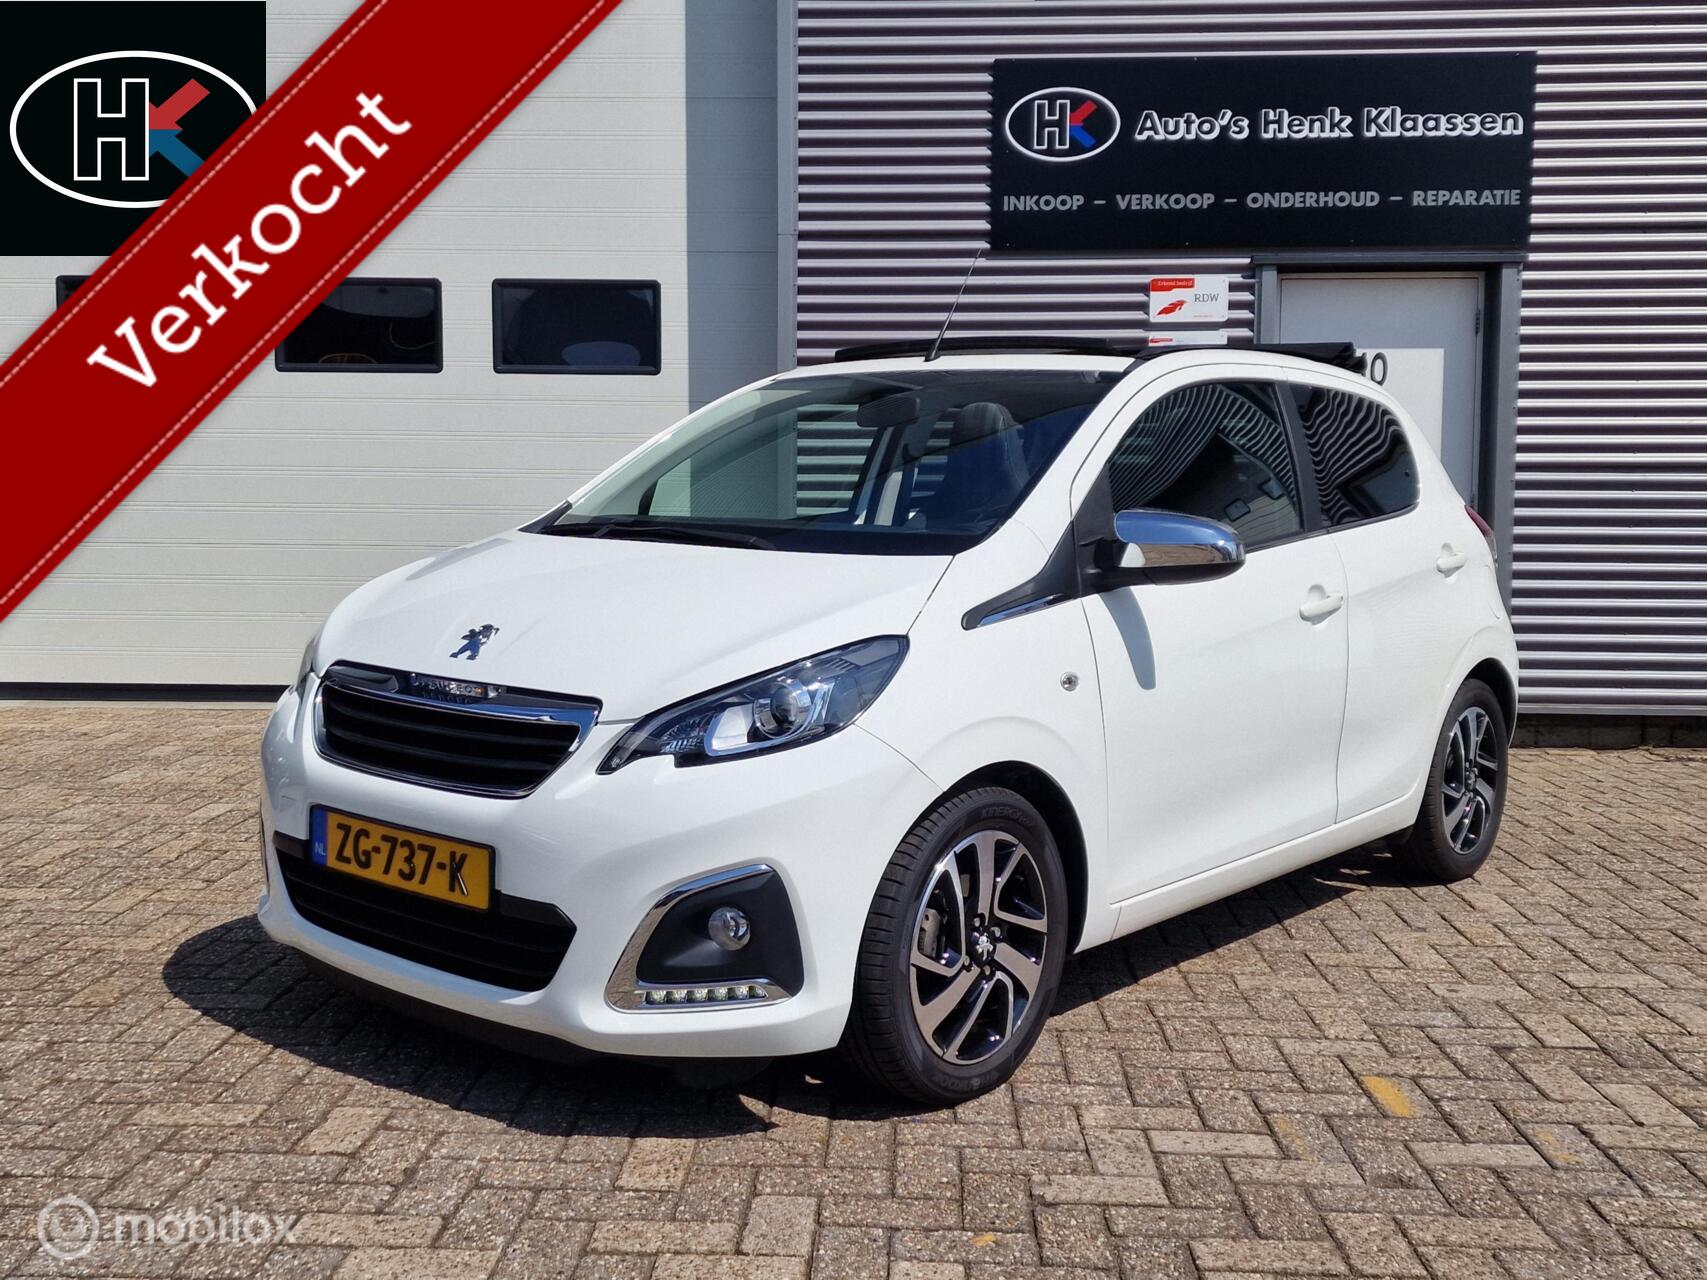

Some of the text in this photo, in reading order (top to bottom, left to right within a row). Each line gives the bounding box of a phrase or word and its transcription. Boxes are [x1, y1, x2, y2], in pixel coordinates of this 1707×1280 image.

[1134, 105, 1524, 140] Auto's Henk Klaassen
[1003, 194, 1085, 211] INKOOP
[1116, 192, 1215, 210] VERKOOP
[1246, 190, 1380, 208] ONDERHOUD
[1412, 189, 1521, 206] REPARATIE
[1194, 293, 1220, 302] RDW
[315, 841, 327, 856] NL
[335, 822, 469, 896] ZG-737-K
